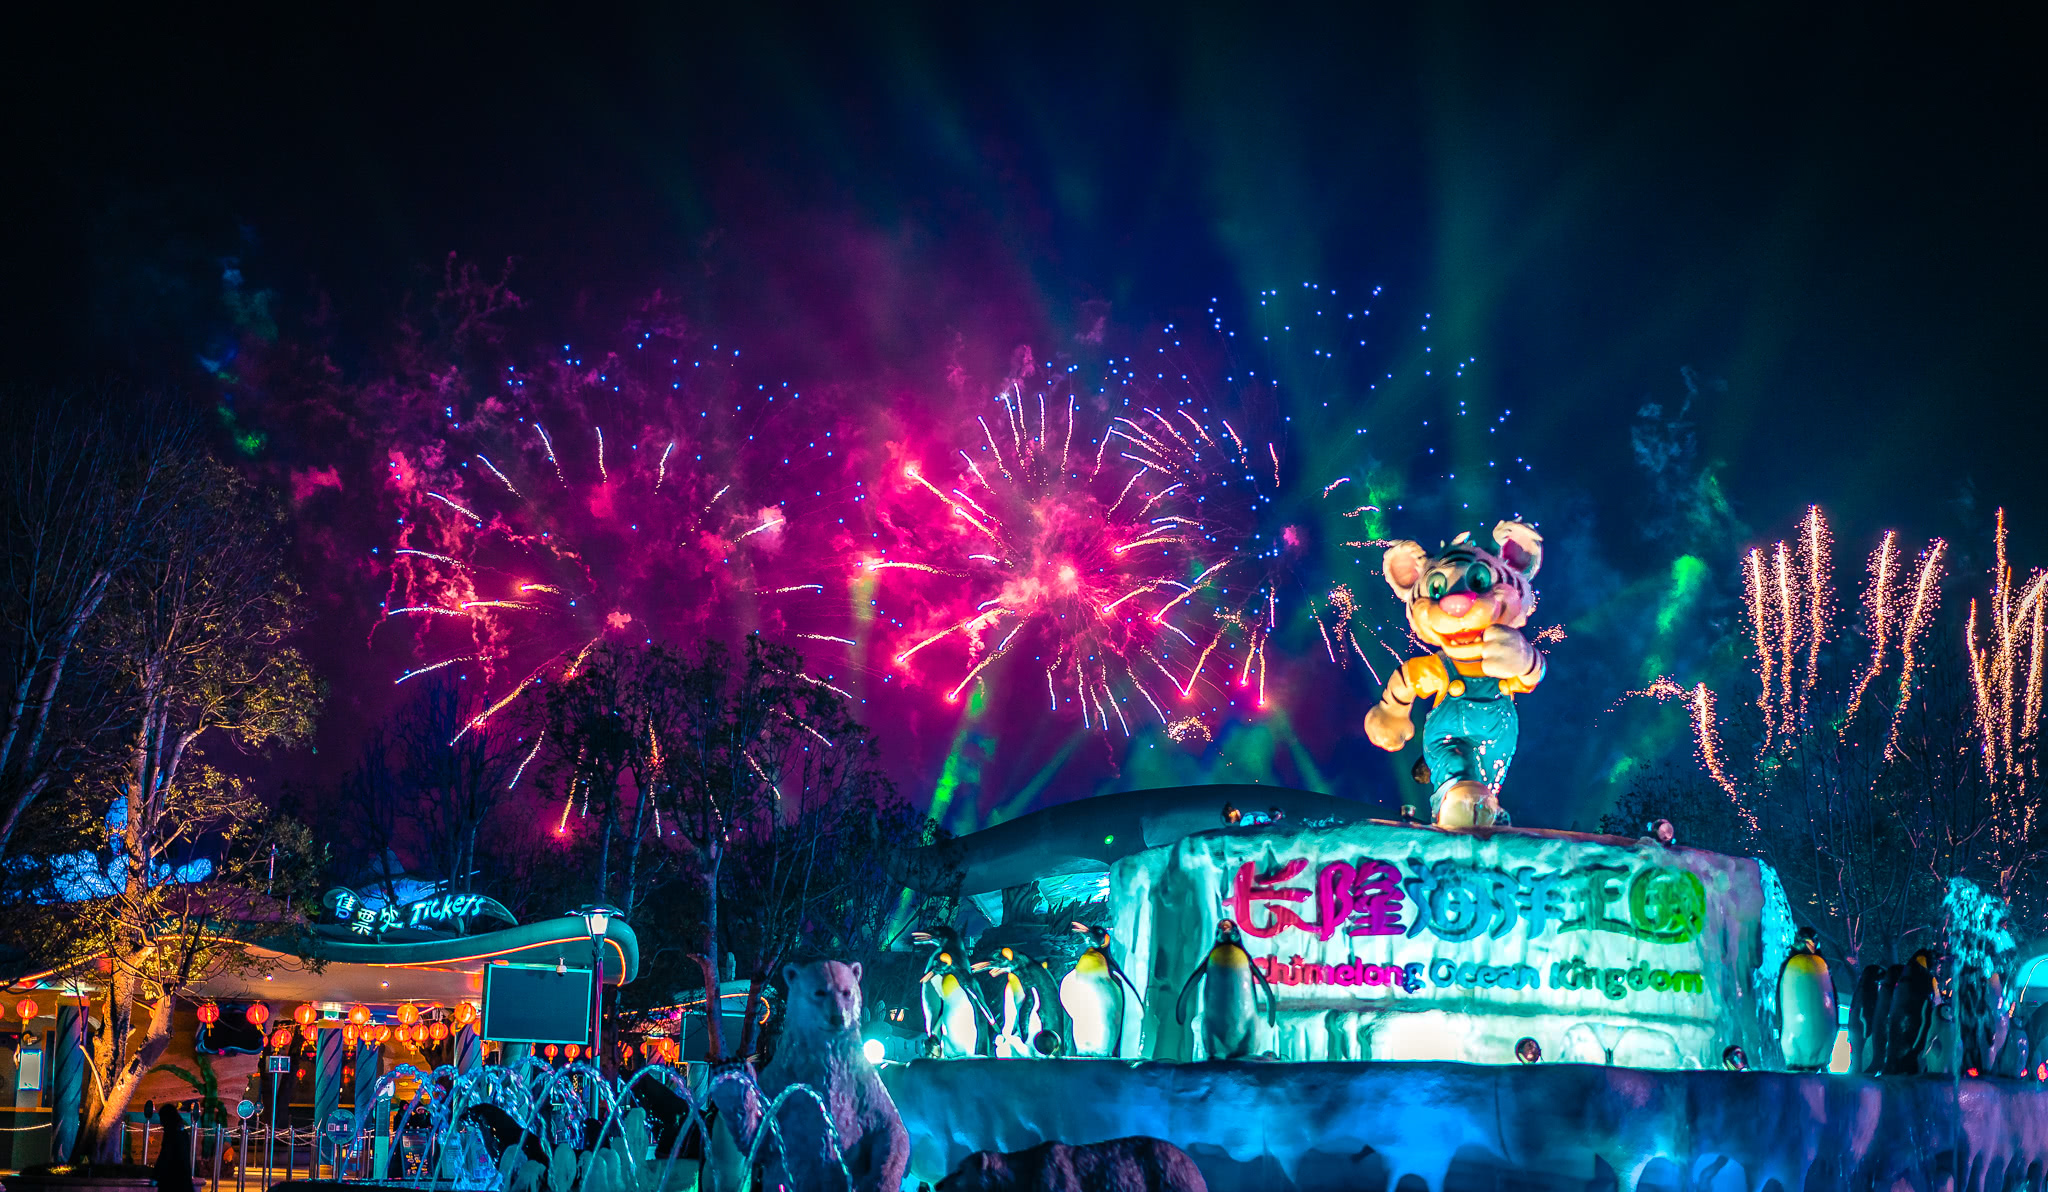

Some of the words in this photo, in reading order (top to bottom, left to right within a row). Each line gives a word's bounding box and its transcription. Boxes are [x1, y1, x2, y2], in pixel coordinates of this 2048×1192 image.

[335, 892, 404, 936] 售票处
[409, 894, 485, 927] Tickets
[1222, 857, 1707, 944] 长隆海洋王国
[1429, 957, 1541, 991] Ocean
[1550, 955, 1704, 1000] Kingdom
